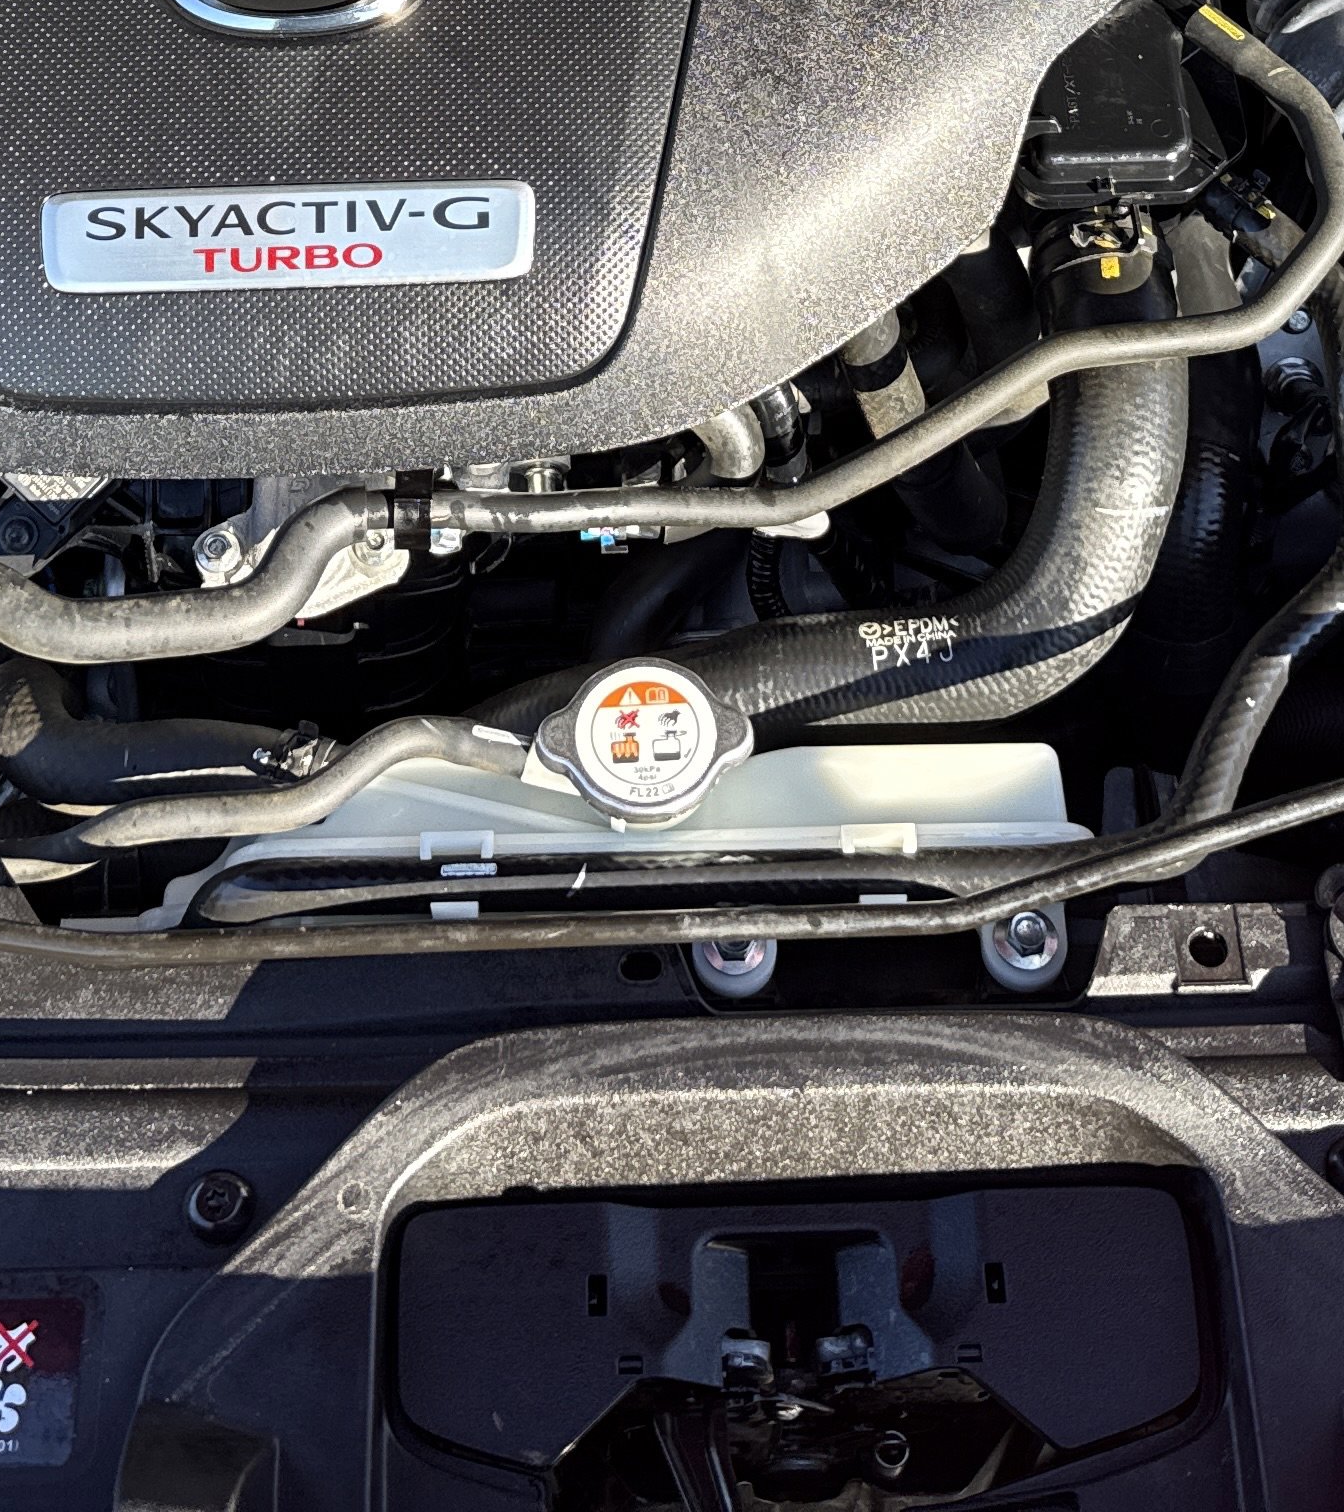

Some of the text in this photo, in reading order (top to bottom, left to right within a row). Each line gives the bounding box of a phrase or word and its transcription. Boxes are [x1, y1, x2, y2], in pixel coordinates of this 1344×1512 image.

[85, 196, 491, 242] SKYACTIV-G
[192, 242, 384, 274] TURBO
[629, 786, 660, 798] FL22
